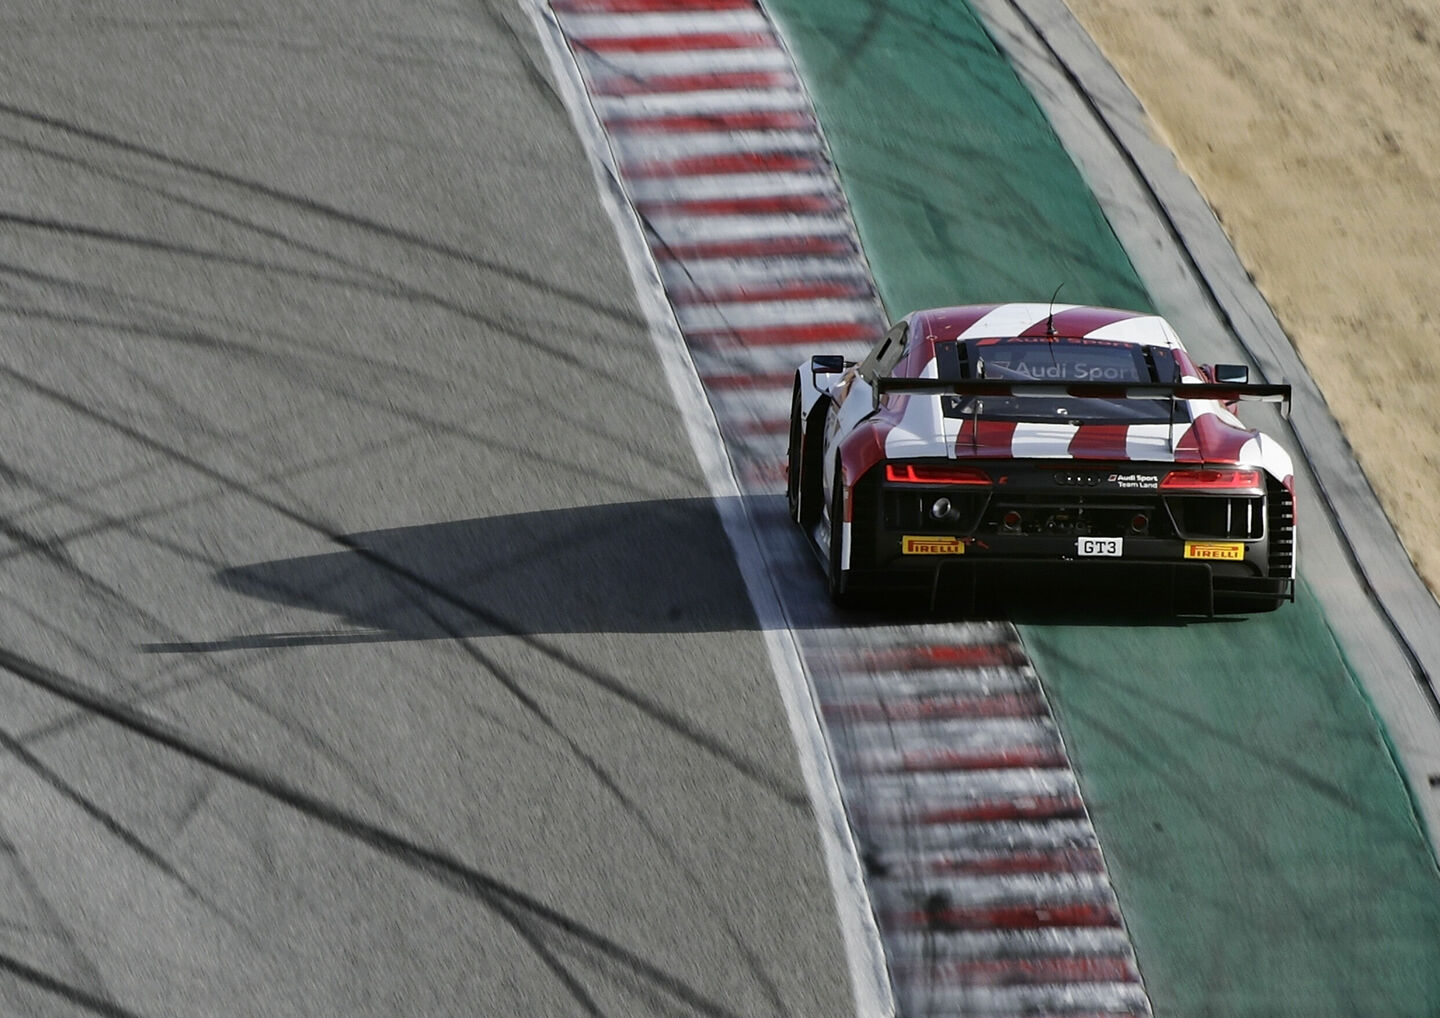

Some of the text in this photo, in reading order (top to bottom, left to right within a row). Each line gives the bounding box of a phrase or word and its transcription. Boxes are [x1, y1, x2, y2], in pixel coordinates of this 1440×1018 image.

[1015, 361, 1138, 381] Audi Sport
[1136, 474, 1158, 482] Sport
[907, 540, 959, 552] PIRELLI
[1084, 541, 1117, 553] GT3
[1190, 544, 1239, 558] PIRELLI
